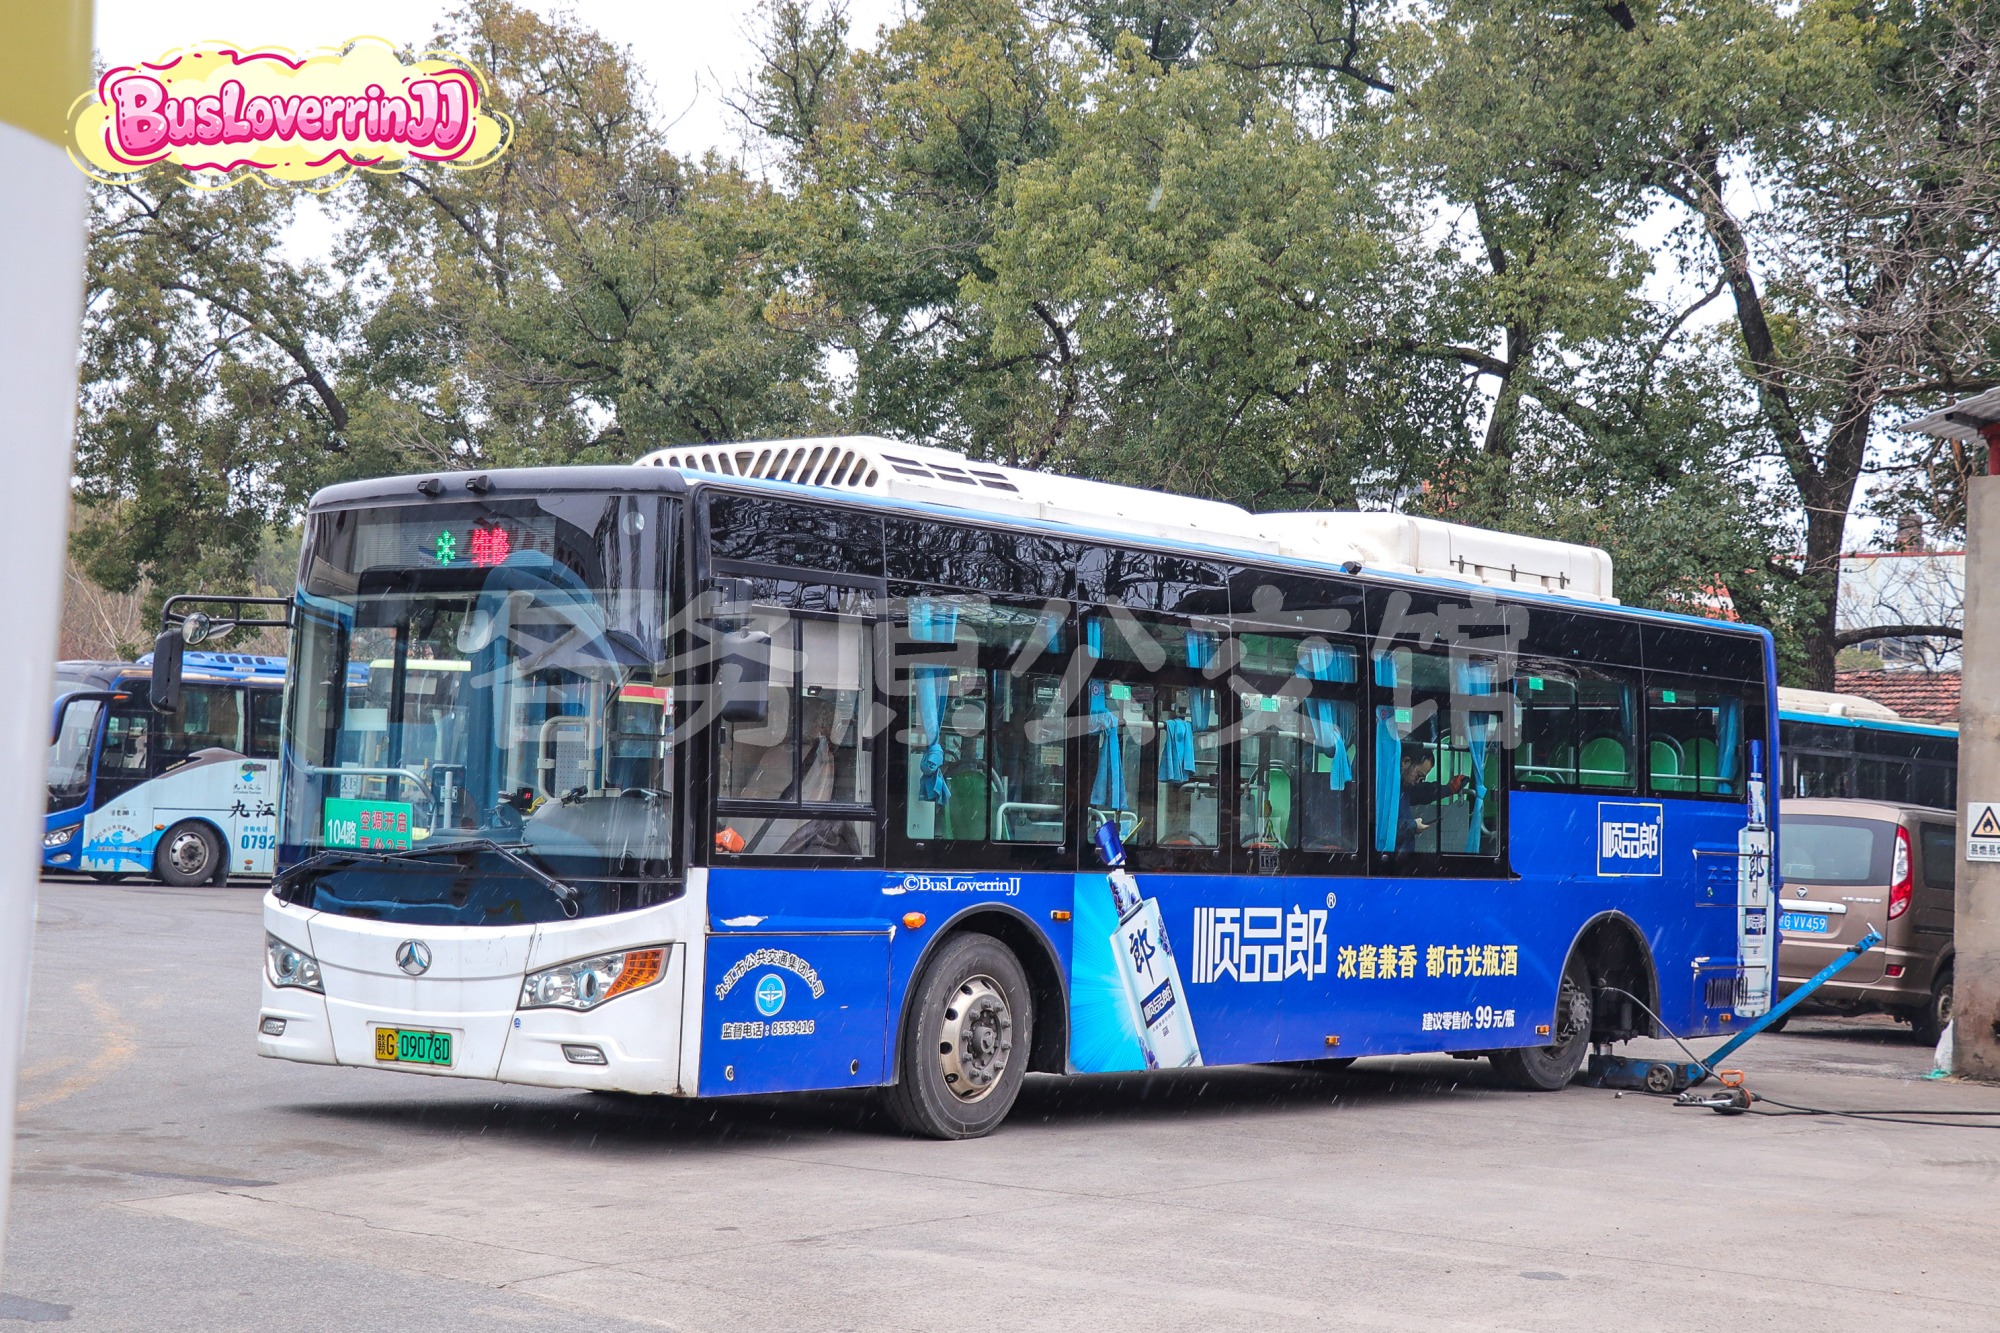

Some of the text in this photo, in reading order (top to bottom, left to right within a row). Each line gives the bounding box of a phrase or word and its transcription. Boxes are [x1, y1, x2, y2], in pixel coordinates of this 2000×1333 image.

[228, 799, 276, 818] 九江
[360, 810, 407, 832] 空调开启
[241, 834, 276, 850] 0792
[328, 818, 357, 845] 104路
[1602, 822, 1659, 859] 顺品郎
[1779, 914, 1827, 931] GVV459
[715, 948, 825, 1001] 九江市公共交通集团公司
[1336, 944, 1518, 980] 浓酱兼香 都市光瓶酒
[377, 1033, 450, 1061] 赣G09078D
